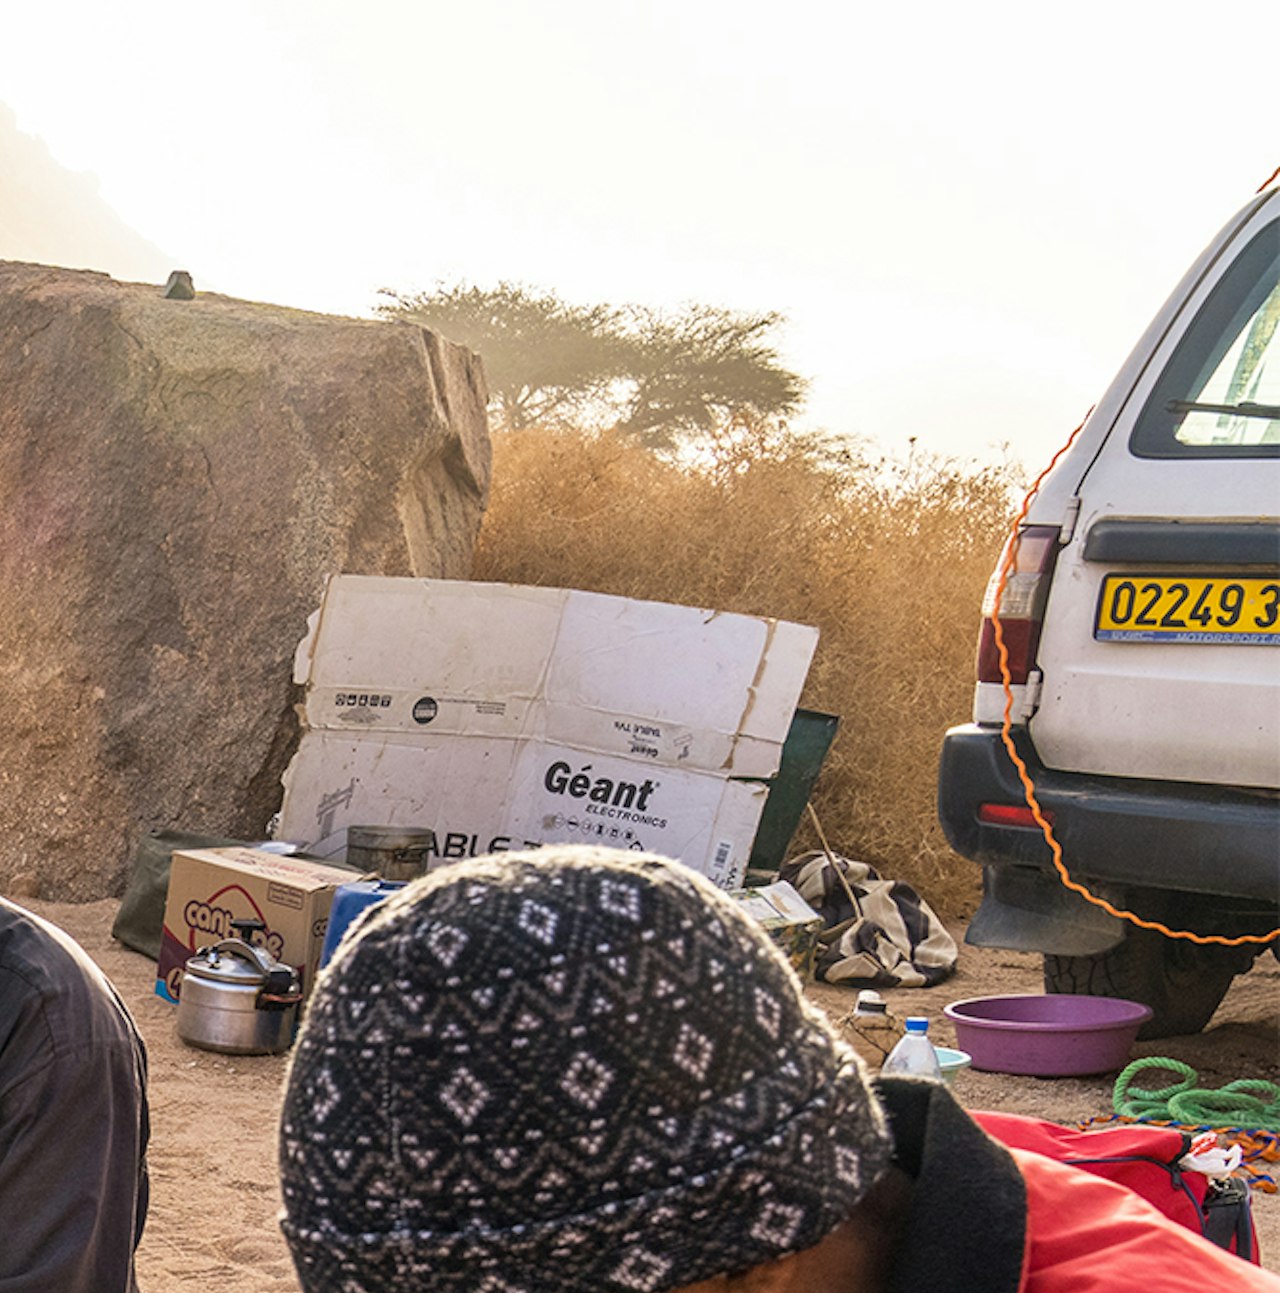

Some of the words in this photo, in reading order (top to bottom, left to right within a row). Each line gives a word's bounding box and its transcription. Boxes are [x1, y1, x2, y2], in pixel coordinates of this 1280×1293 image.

[1109, 581, 1246, 628] 02249
[544, 760, 656, 812] Géant
[585, 804, 668, 830] ELECTRONICS
